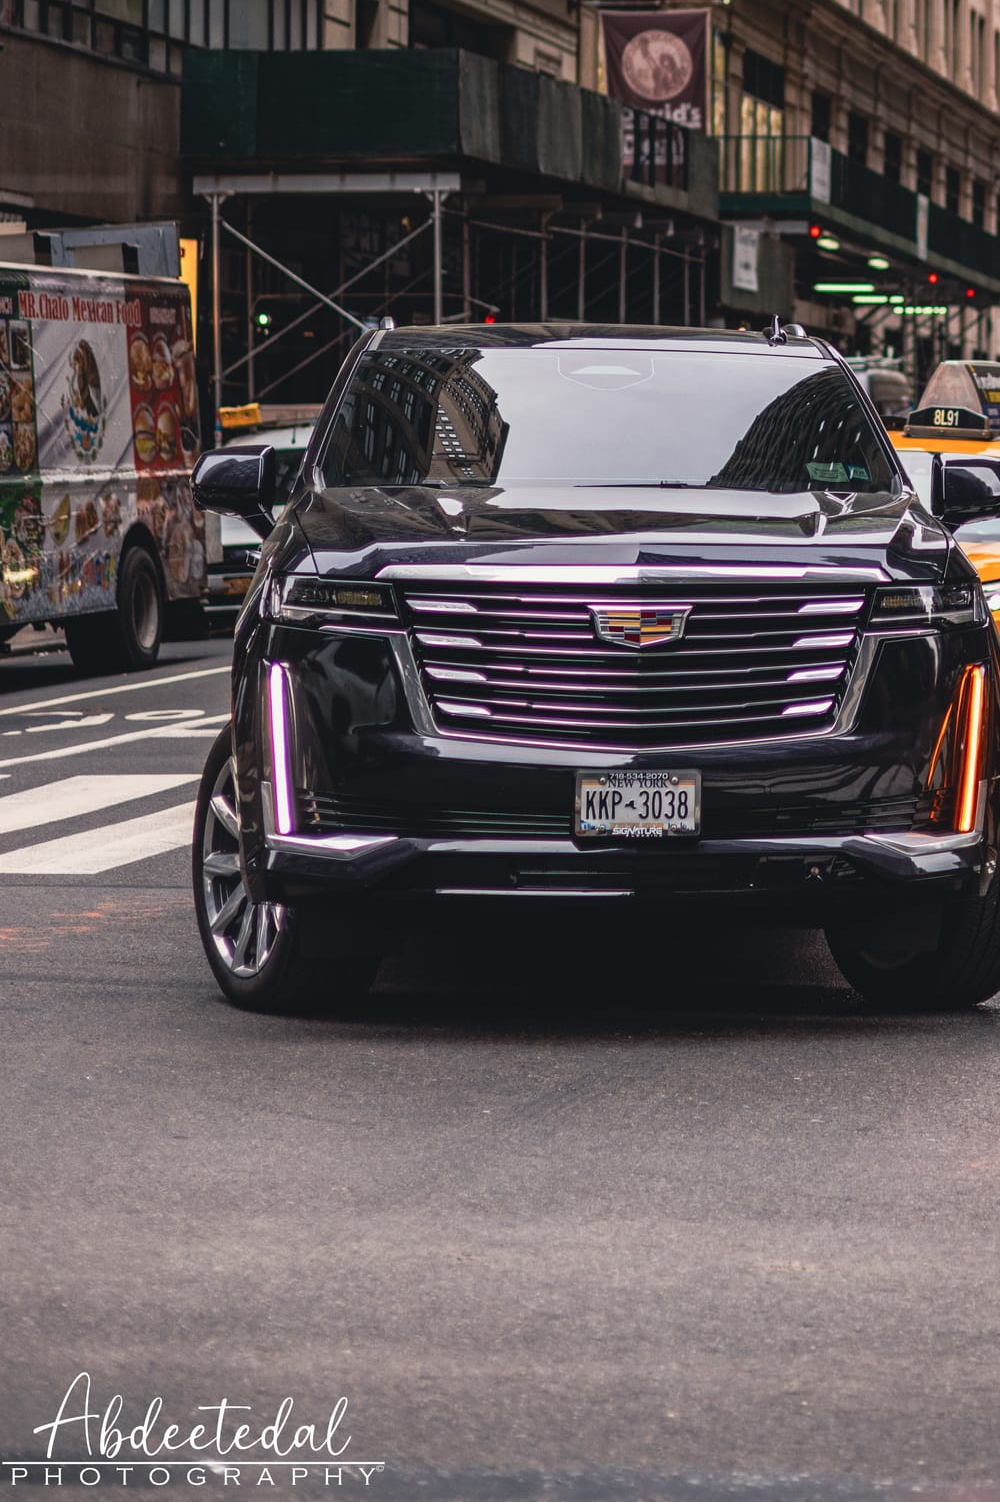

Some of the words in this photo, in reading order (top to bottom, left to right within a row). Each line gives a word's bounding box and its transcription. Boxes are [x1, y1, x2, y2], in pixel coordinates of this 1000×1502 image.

[72, 295, 113, 324] Mexican
[116, 299, 142, 327] Food
[934, 409, 959, 426] 8L91
[608, 779, 633, 788] NEW
[639, 779, 668, 788] YORK
